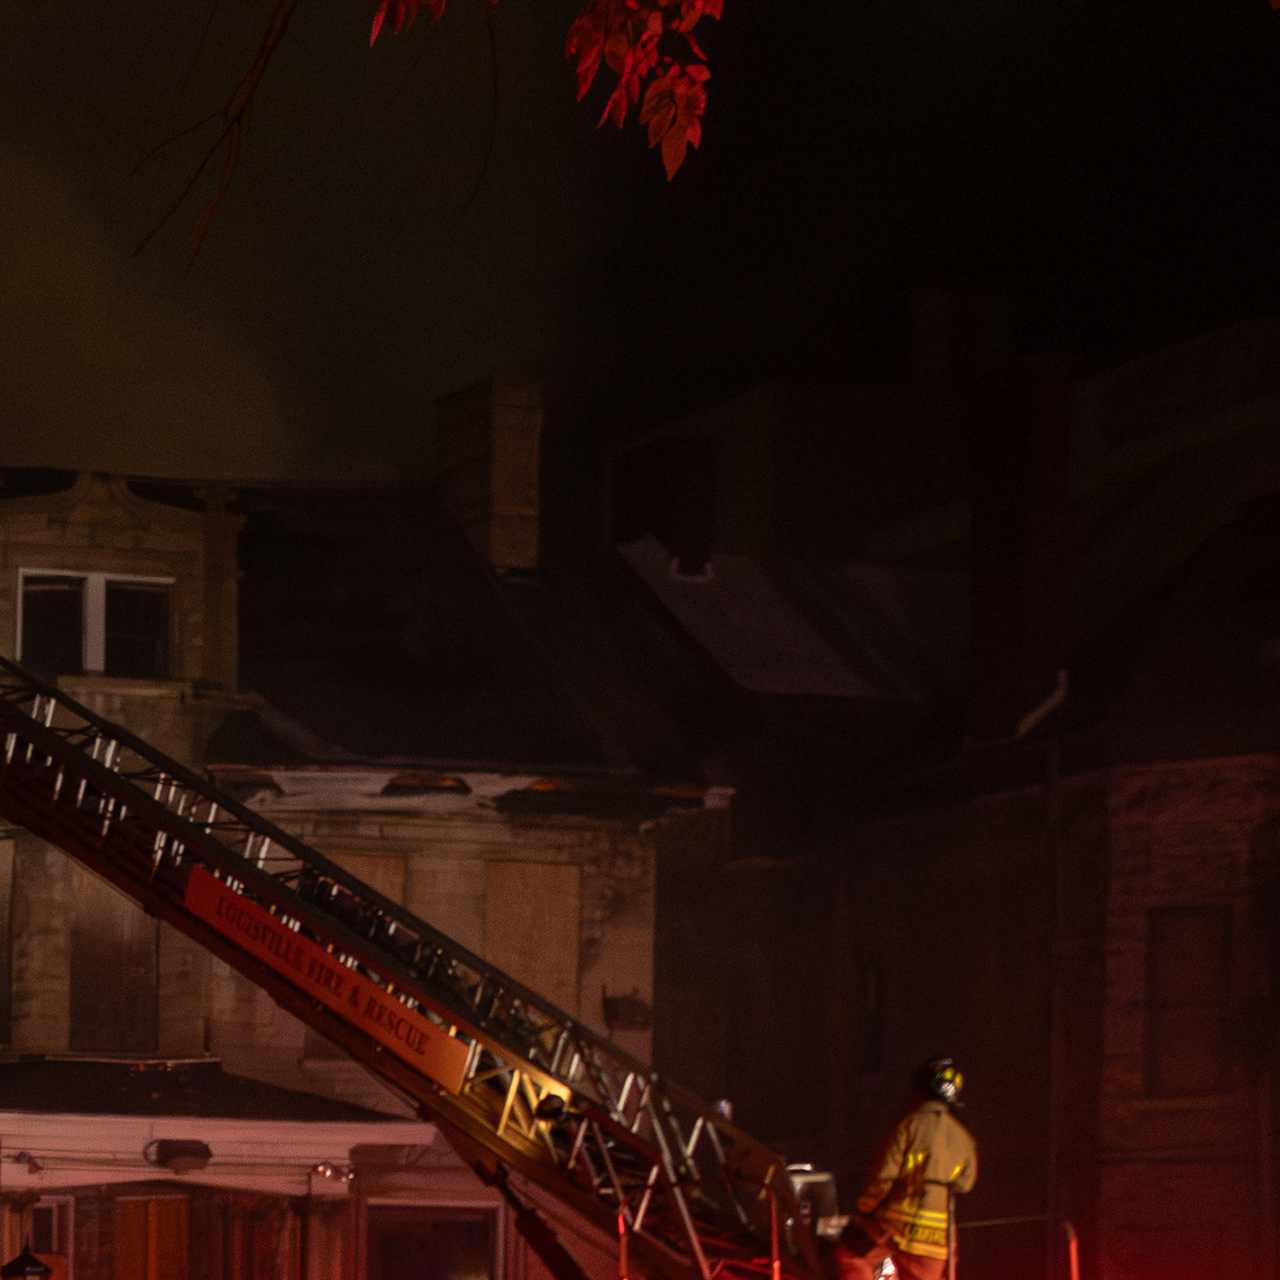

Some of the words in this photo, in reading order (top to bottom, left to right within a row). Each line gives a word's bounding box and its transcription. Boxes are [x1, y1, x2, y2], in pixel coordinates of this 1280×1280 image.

[215, 895, 306, 971] LOUISVILLE
[306, 955, 344, 998] FIRE
[347, 985, 361, 1009] &
[363, 996, 430, 1056] RESCUE
